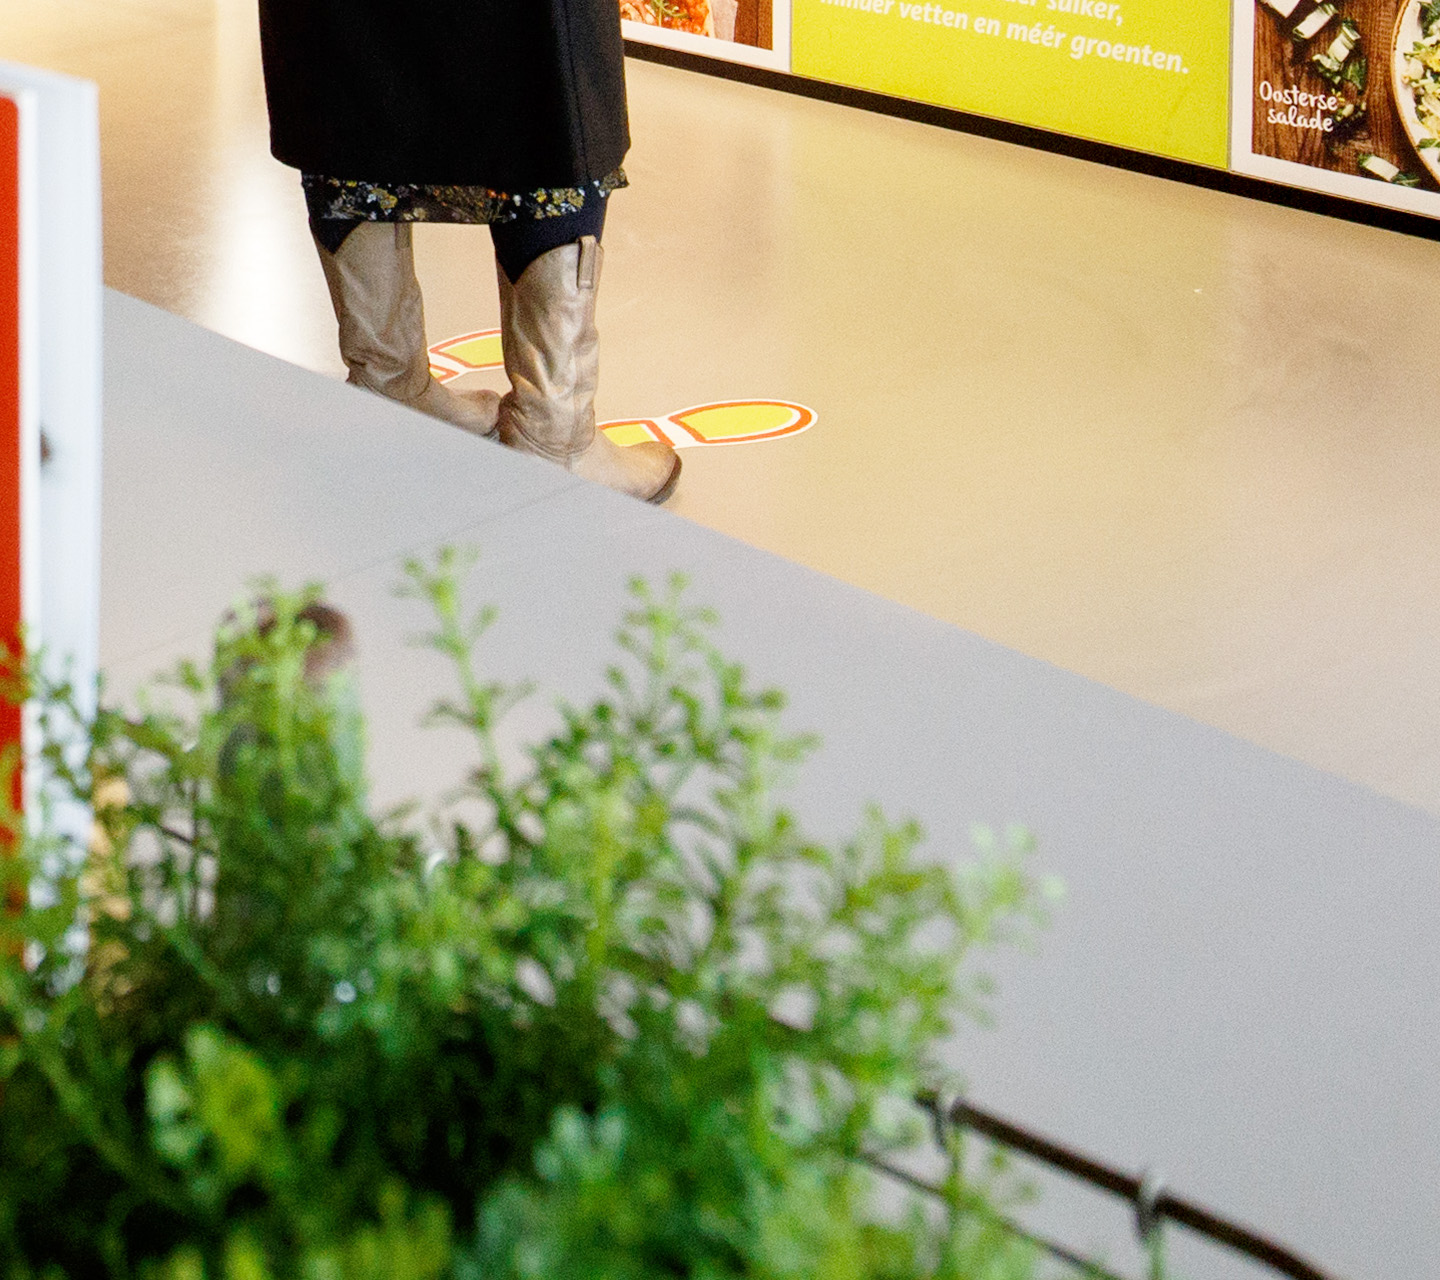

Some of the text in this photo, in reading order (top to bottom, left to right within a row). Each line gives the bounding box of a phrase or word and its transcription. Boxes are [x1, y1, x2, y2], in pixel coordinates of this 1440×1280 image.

[899, 0, 968, 30] vetten
[974, 14, 1000, 34] en
[1006, 19, 1064, 49] méér
[1070, 34, 1189, 74] groenten.
[1260, 80, 1338, 112] Oosterse
[1267, 104, 1334, 133] salade
